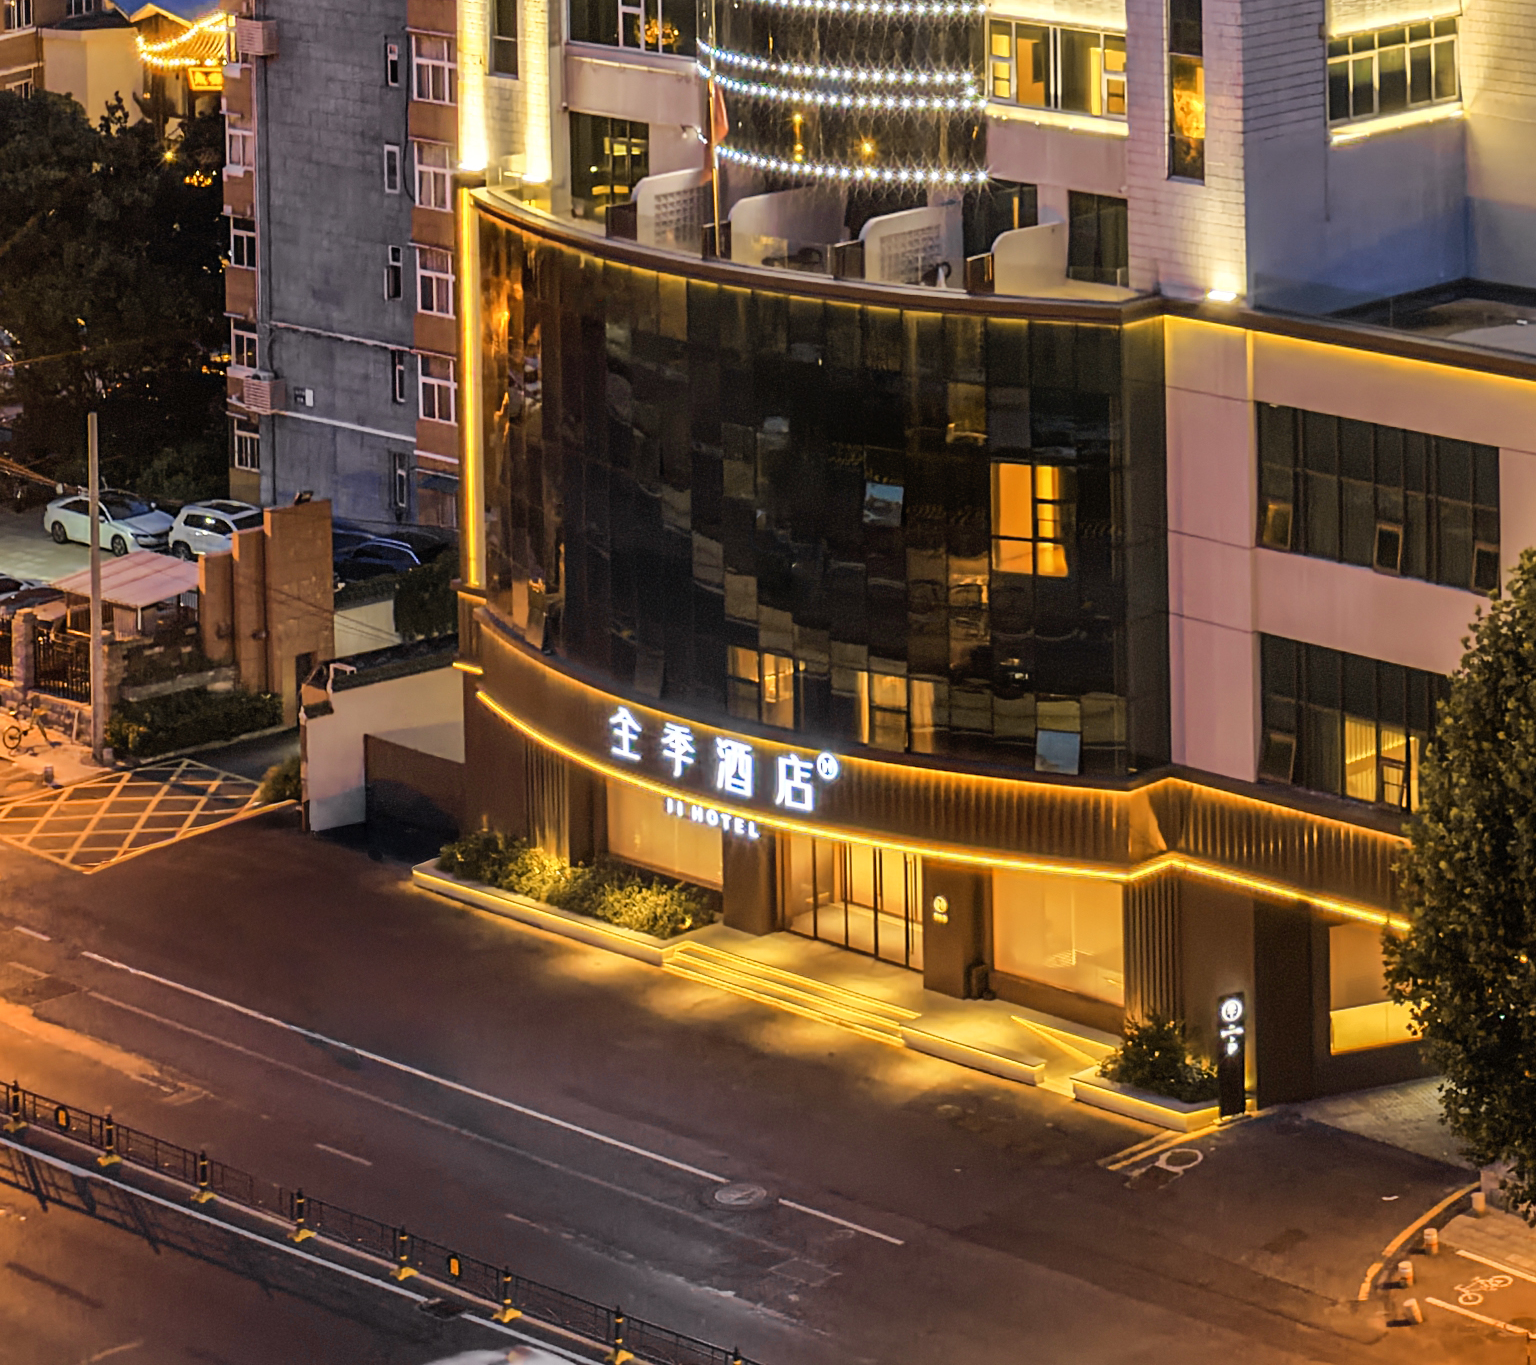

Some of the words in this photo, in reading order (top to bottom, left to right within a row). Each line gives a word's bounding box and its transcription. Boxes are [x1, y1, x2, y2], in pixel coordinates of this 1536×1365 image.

[609, 706, 814, 813] 全季酒店
[691, 804, 761, 839] HOTEL
